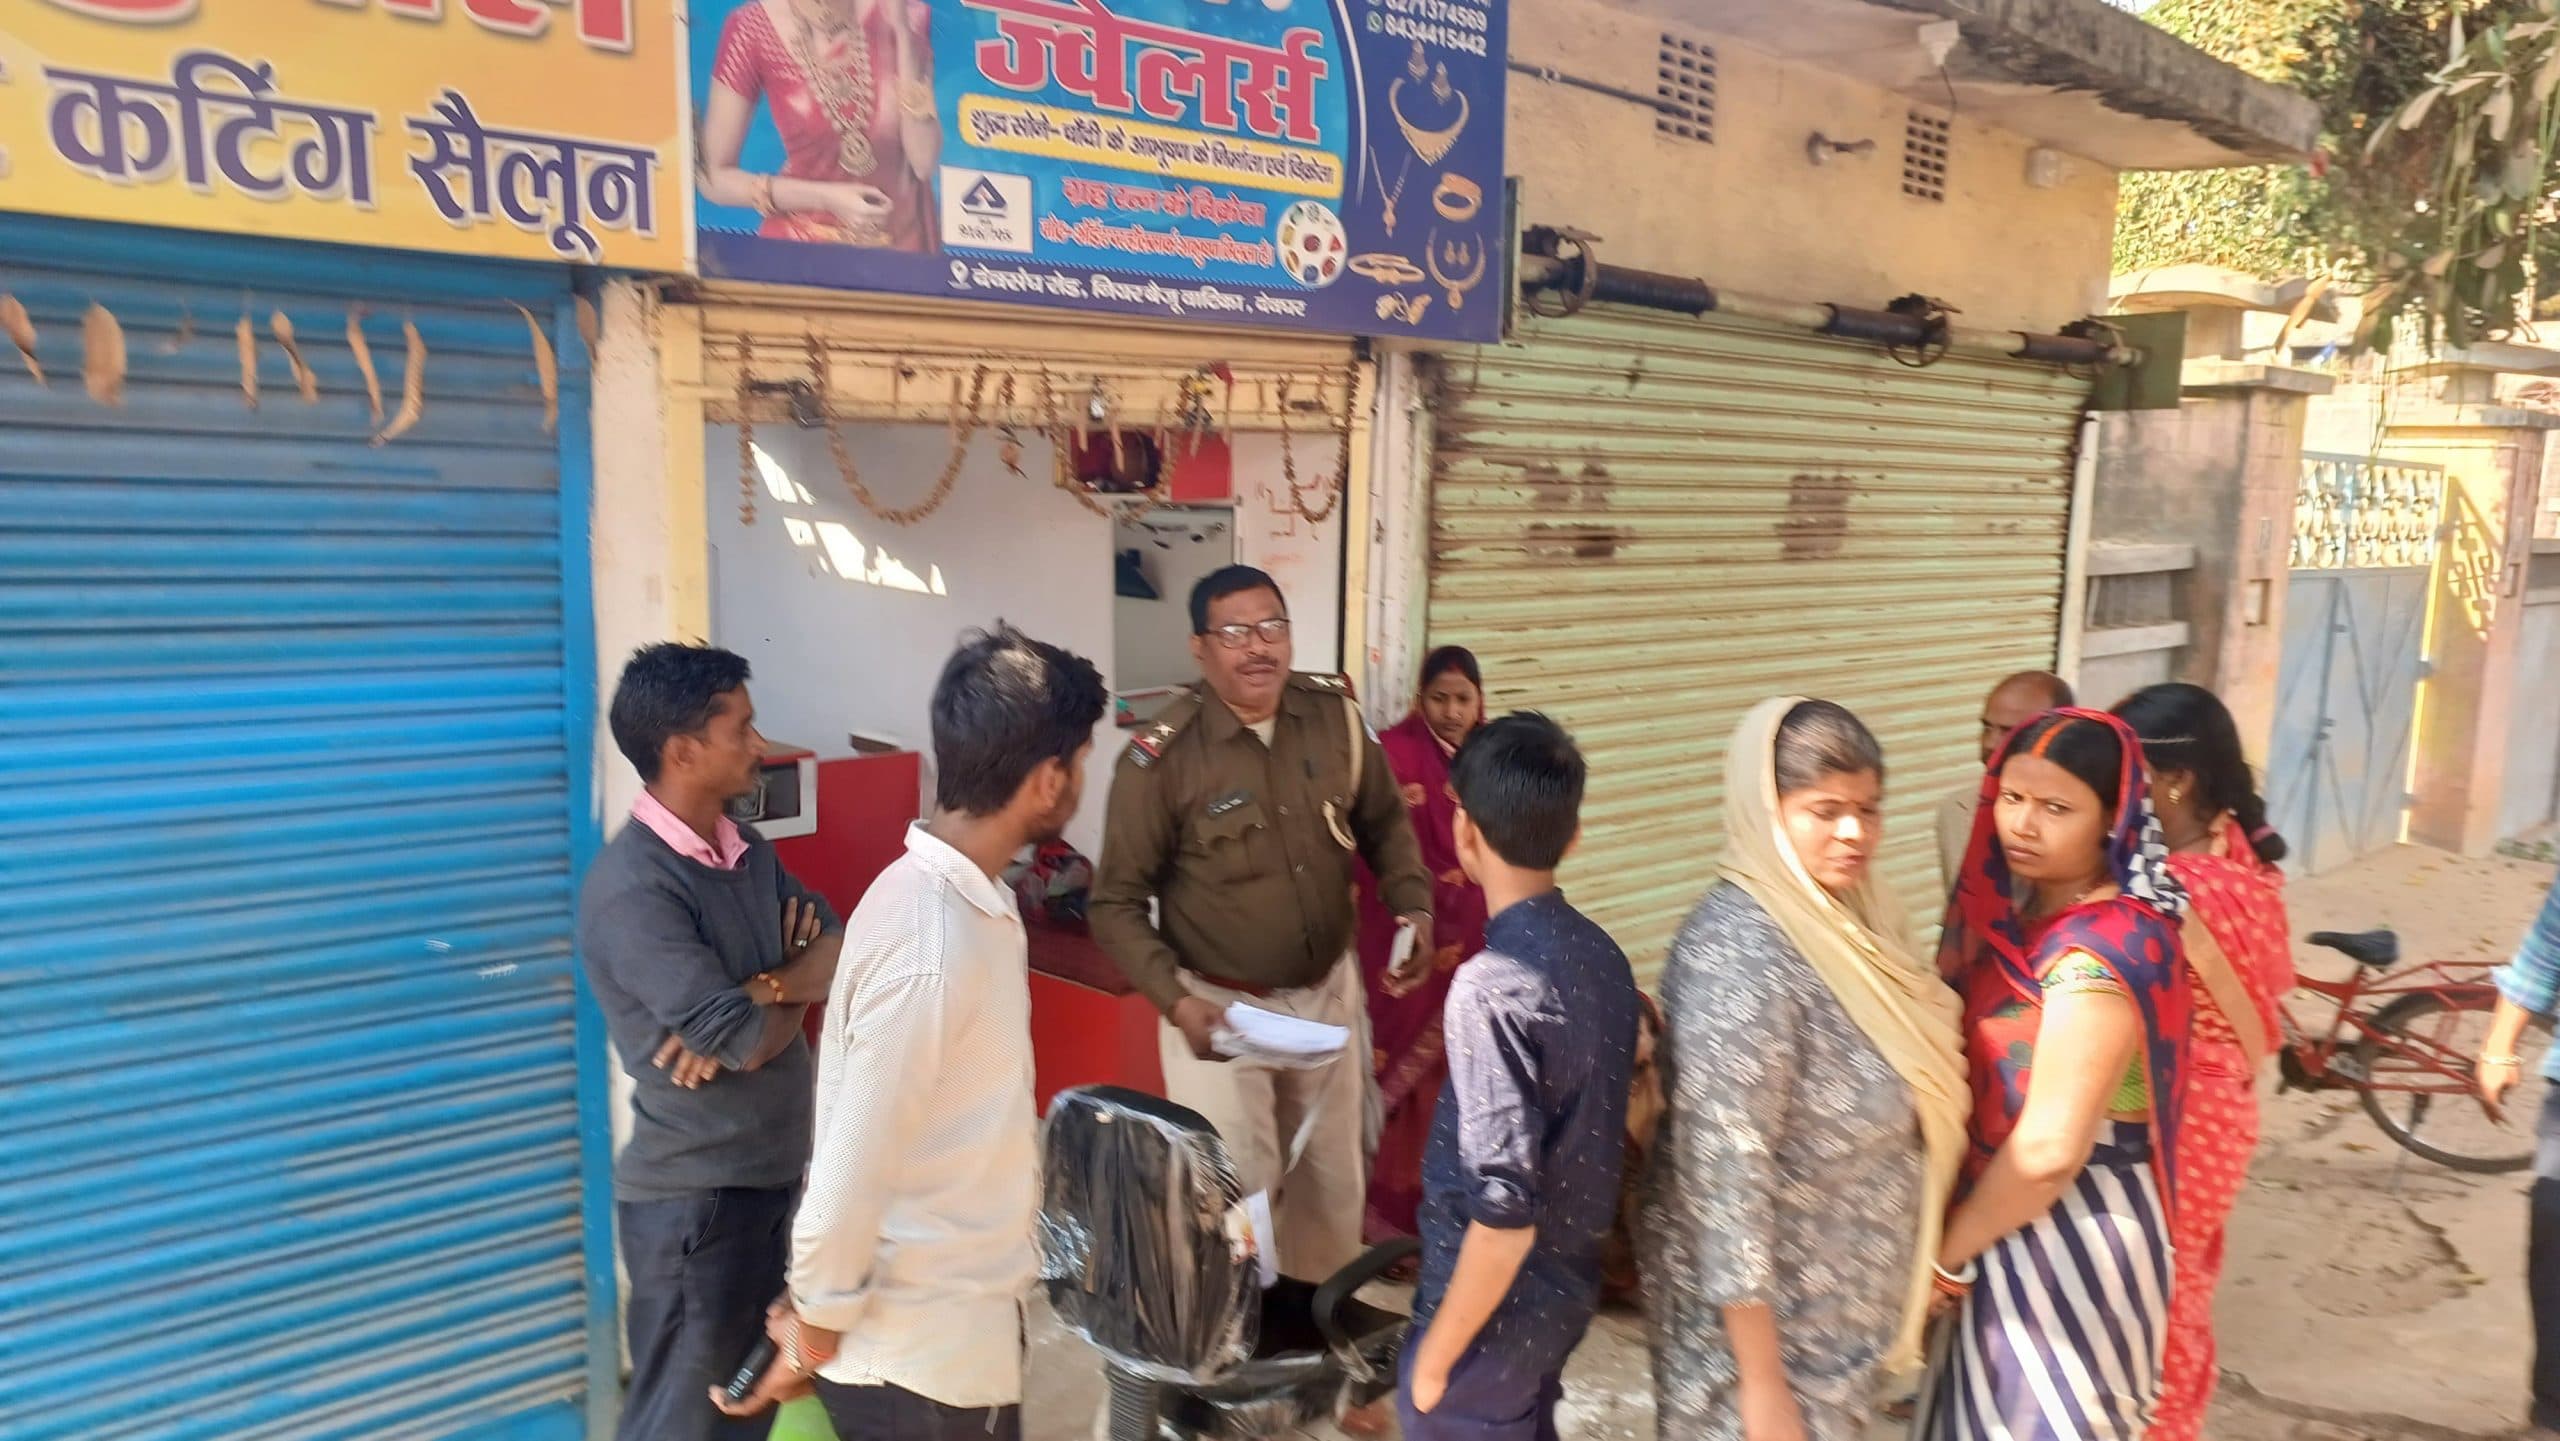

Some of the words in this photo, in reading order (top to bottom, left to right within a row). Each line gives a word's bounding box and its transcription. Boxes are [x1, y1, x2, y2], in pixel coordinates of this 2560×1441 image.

[1384, 13, 1487, 57] 8434415442
[43, 49, 375, 203] कटिंग
[406, 89, 655, 257] सैलून
